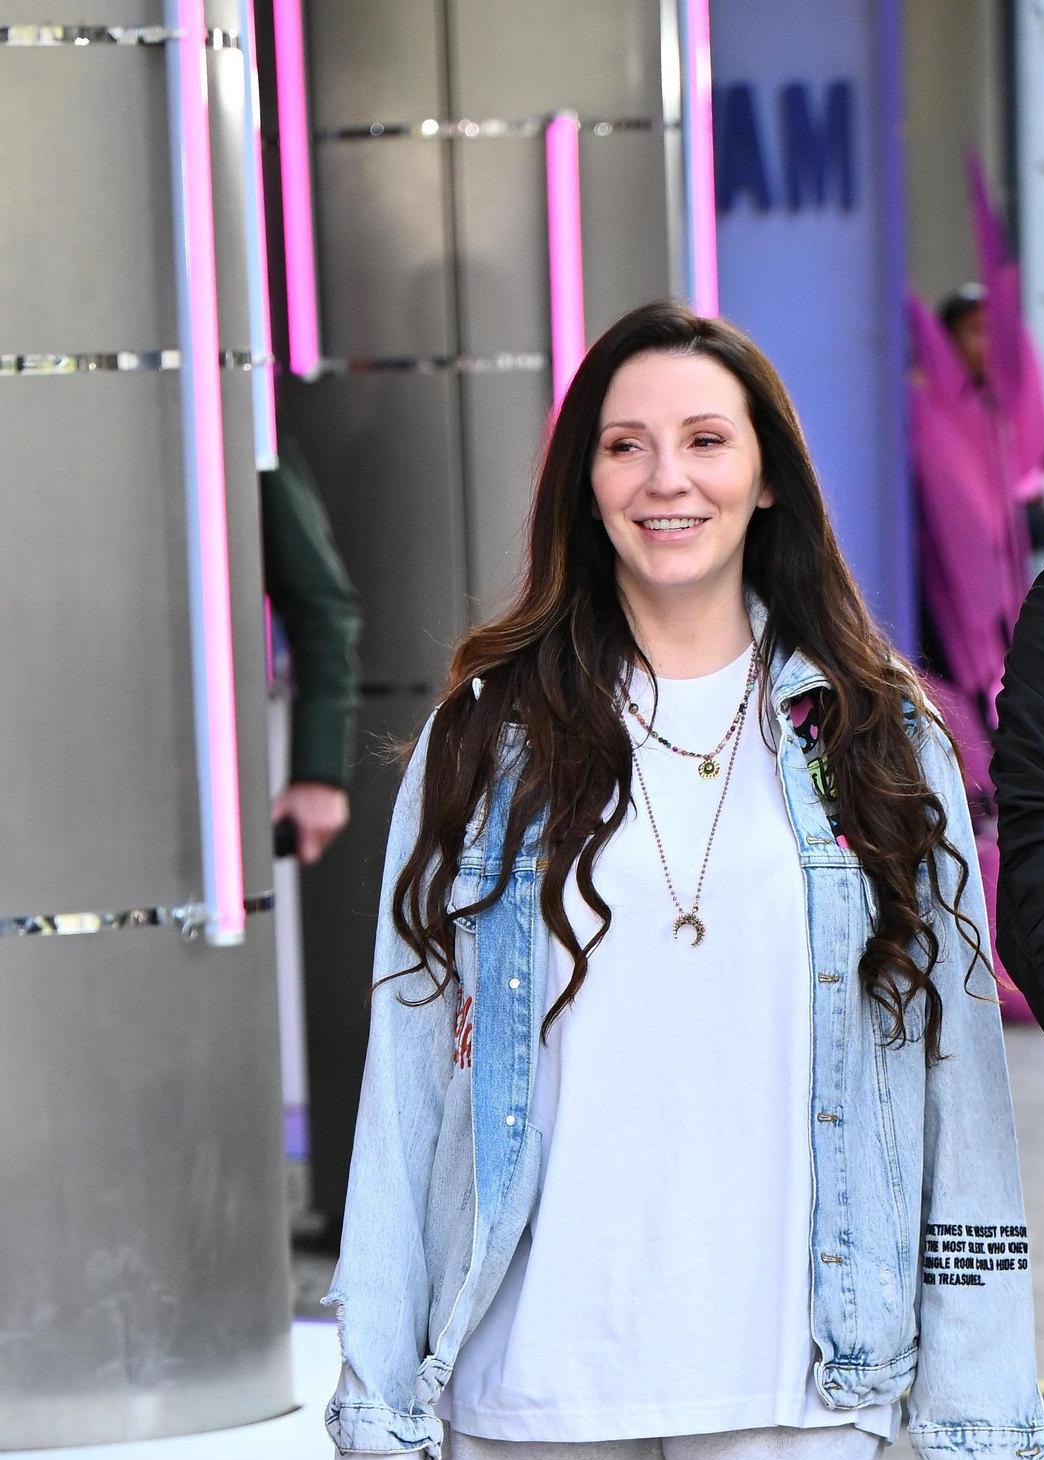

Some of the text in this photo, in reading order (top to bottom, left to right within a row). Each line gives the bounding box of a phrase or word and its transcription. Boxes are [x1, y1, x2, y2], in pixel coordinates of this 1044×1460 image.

[942, 1240, 967, 1252] MOST
[987, 1242, 1006, 1254] WHO
[1017, 1258, 1028, 1270] SO
